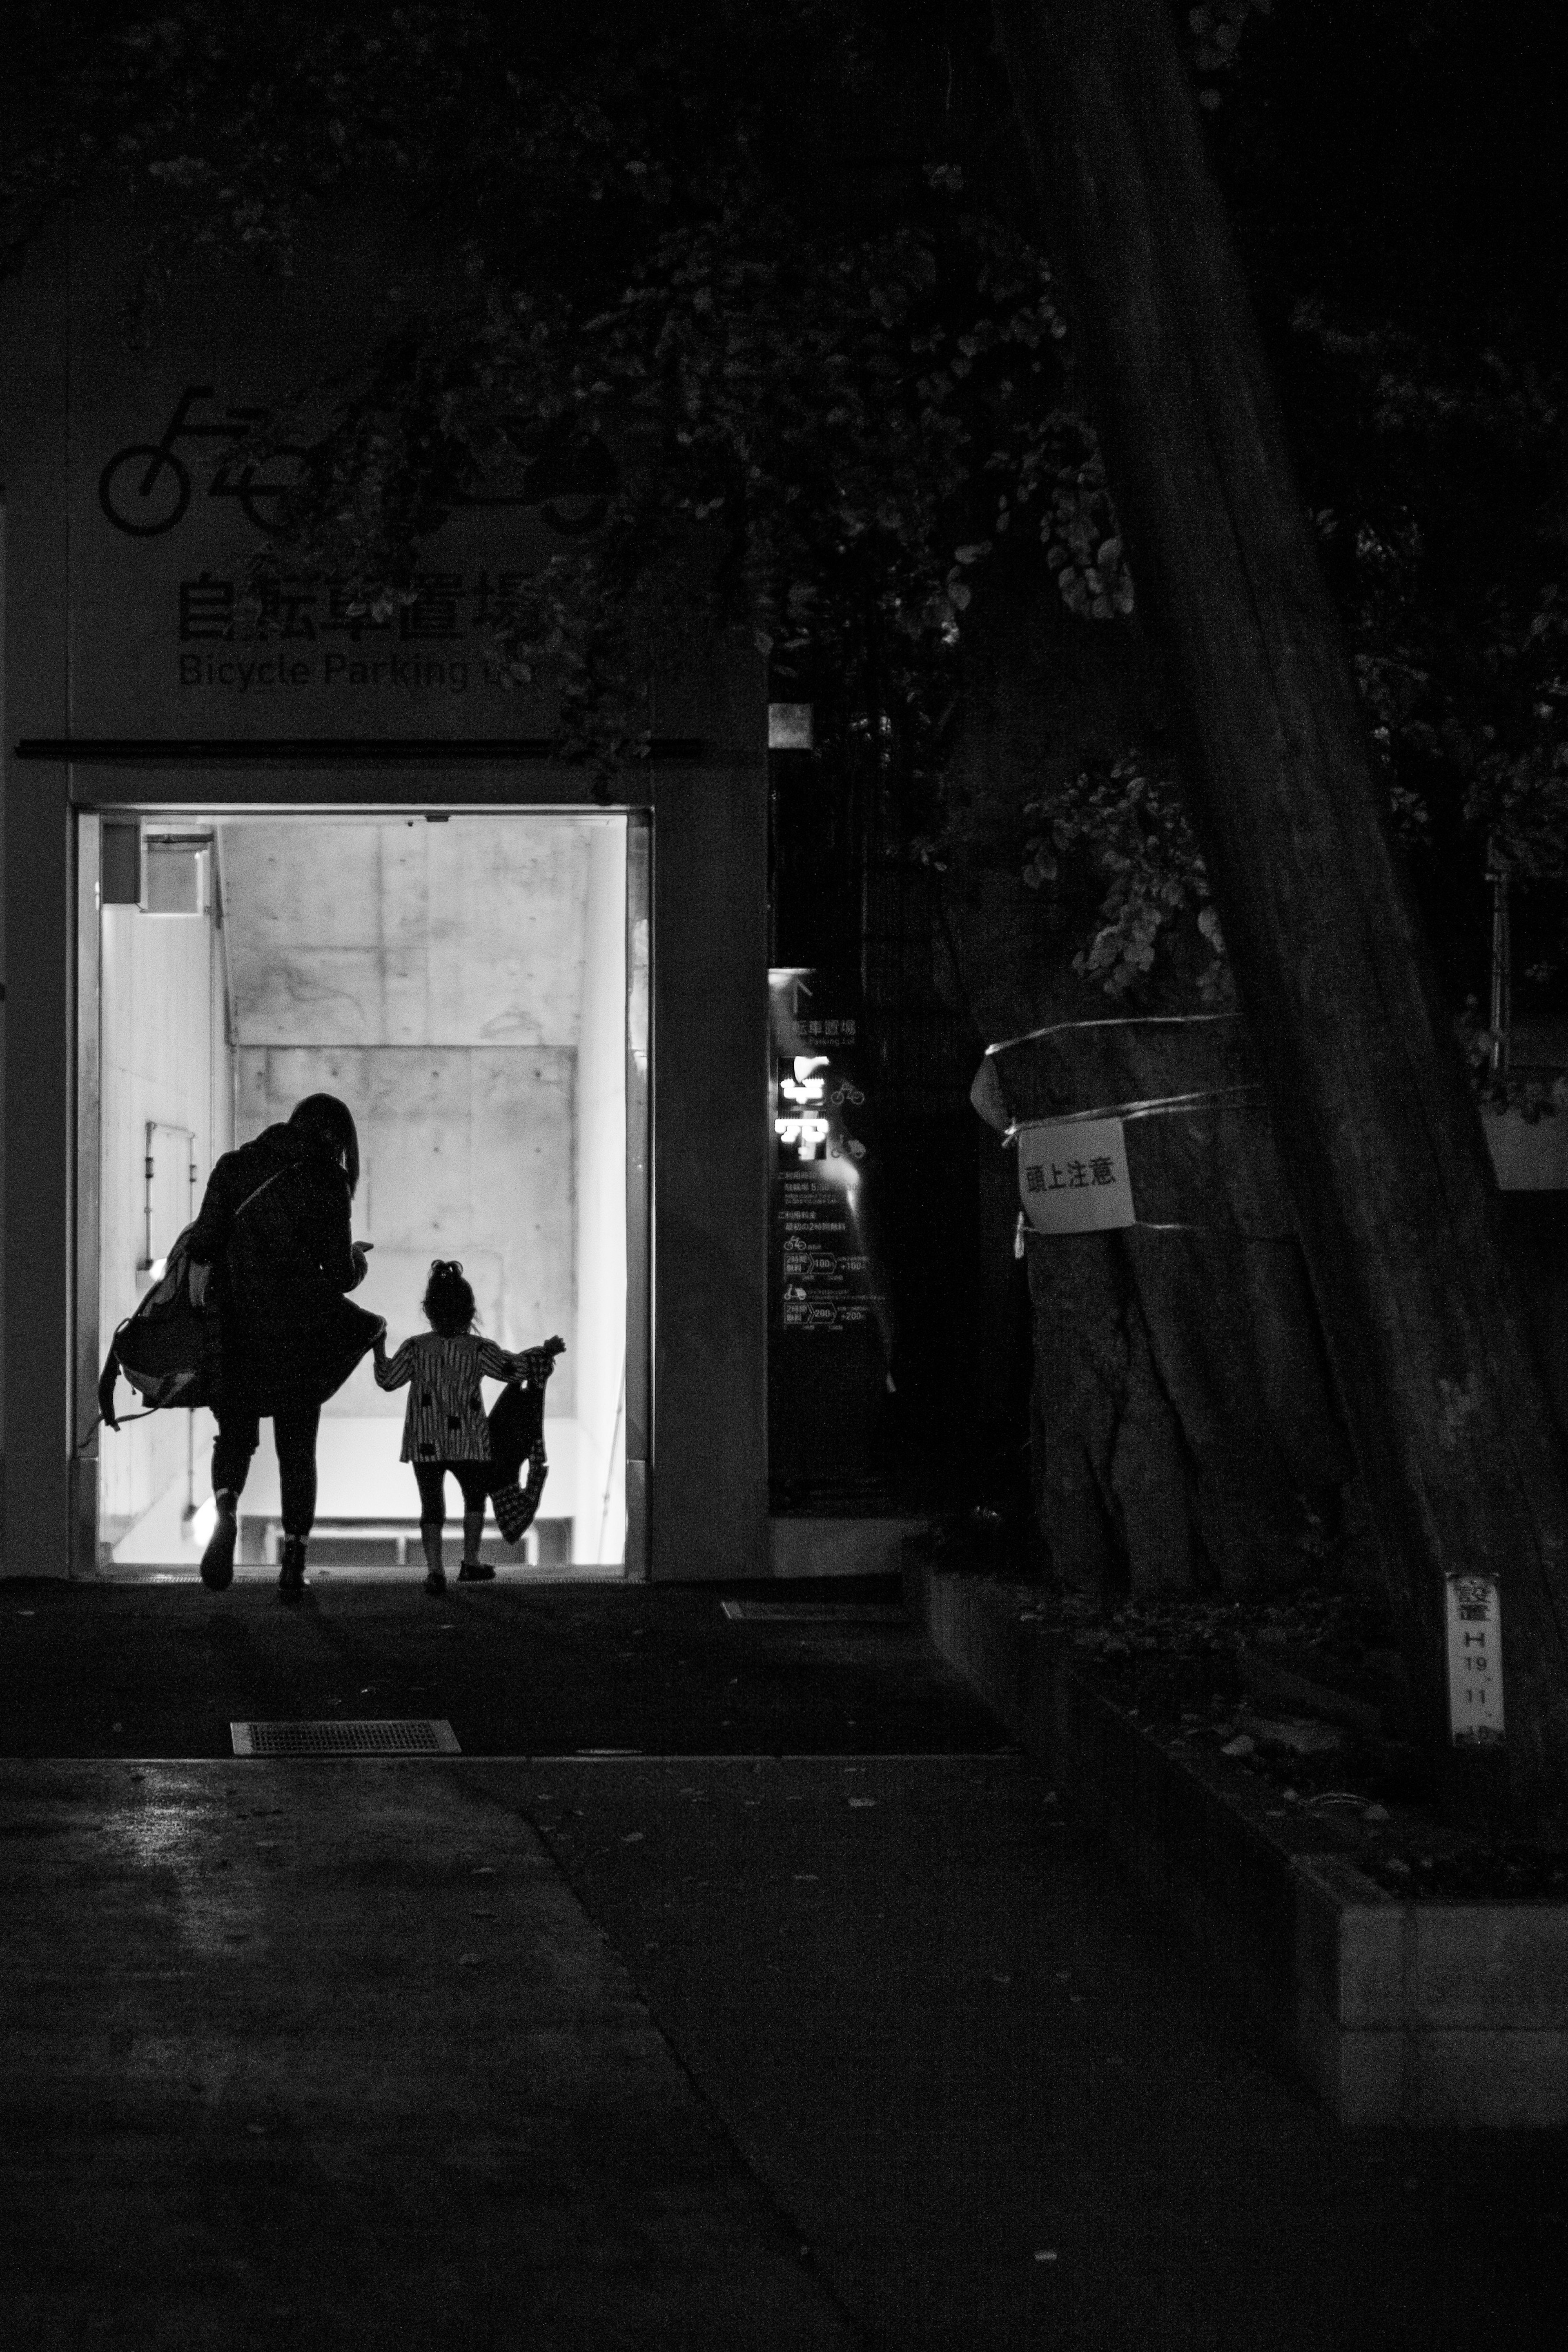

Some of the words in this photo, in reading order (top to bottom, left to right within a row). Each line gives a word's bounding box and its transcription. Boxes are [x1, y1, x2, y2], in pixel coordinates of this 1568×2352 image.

[180, 654, 310, 693] Bicycle
[325, 654, 469, 693] Parking
[1025, 1156, 1116, 1193] 頭上注意
[1464, 1631, 1485, 1647] H
